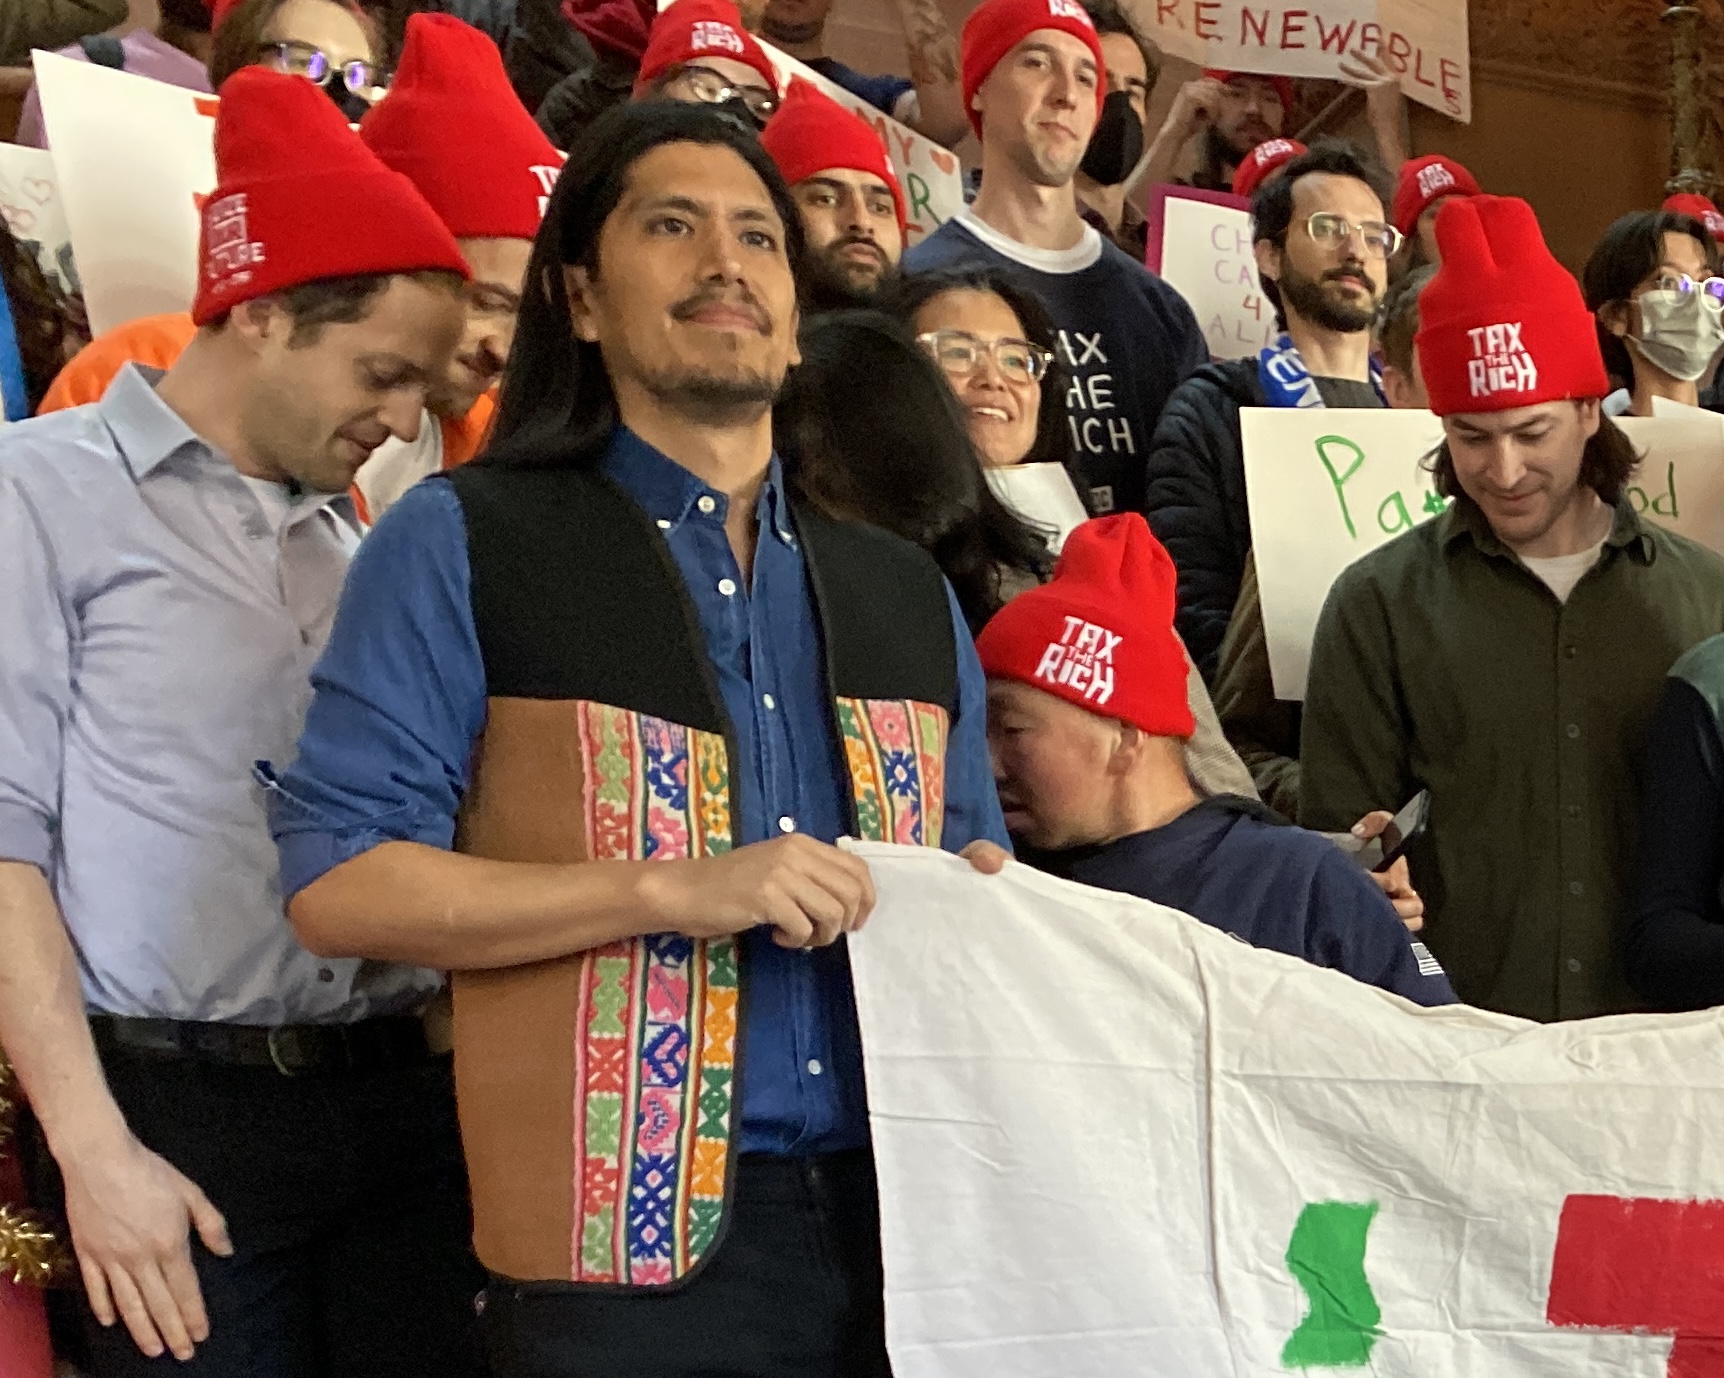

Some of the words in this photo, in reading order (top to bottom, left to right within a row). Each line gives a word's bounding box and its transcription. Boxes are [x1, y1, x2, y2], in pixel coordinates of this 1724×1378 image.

[1466, 321, 1526, 358] TAX
[1065, 373, 1116, 411] HE
[1467, 352, 1538, 398] RICH
[1067, 414, 1136, 454] ICH
[1060, 614, 1124, 665] TAX
[1034, 642, 1115, 705] RICH
